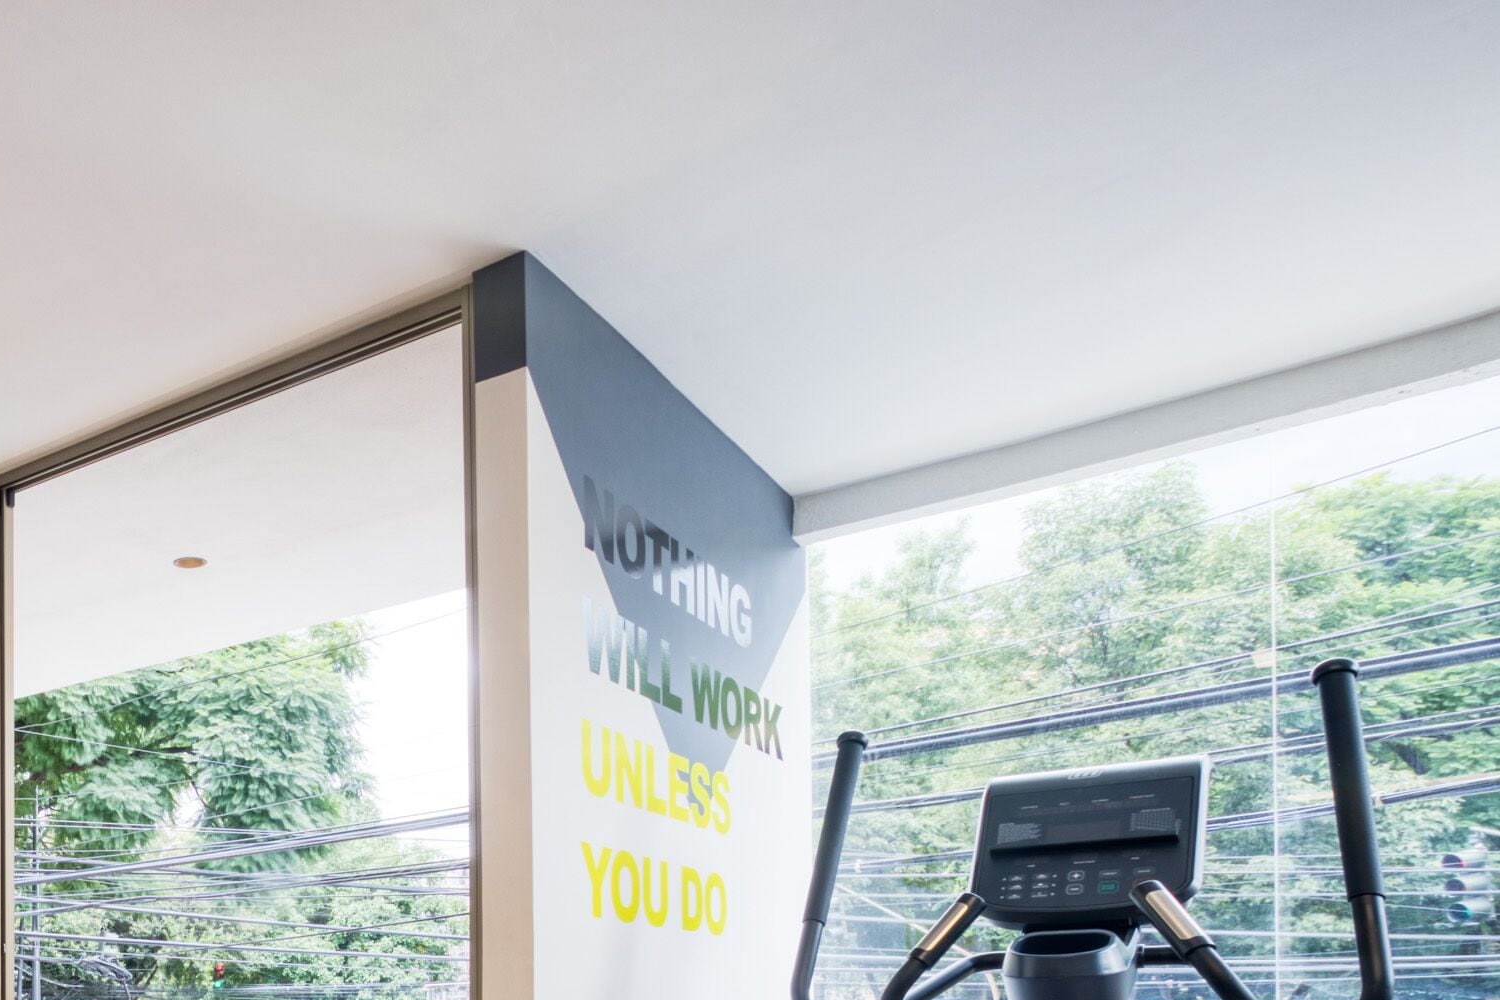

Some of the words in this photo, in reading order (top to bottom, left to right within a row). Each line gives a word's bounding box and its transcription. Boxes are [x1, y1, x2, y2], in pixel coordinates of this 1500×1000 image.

[584, 474, 752, 648] NOTHING
[582, 594, 683, 715] WILL
[690, 655, 783, 762] WORK
[581, 718, 731, 835] UNLESS
[580, 841, 668, 928] YOU
[681, 865, 727, 936] DO
